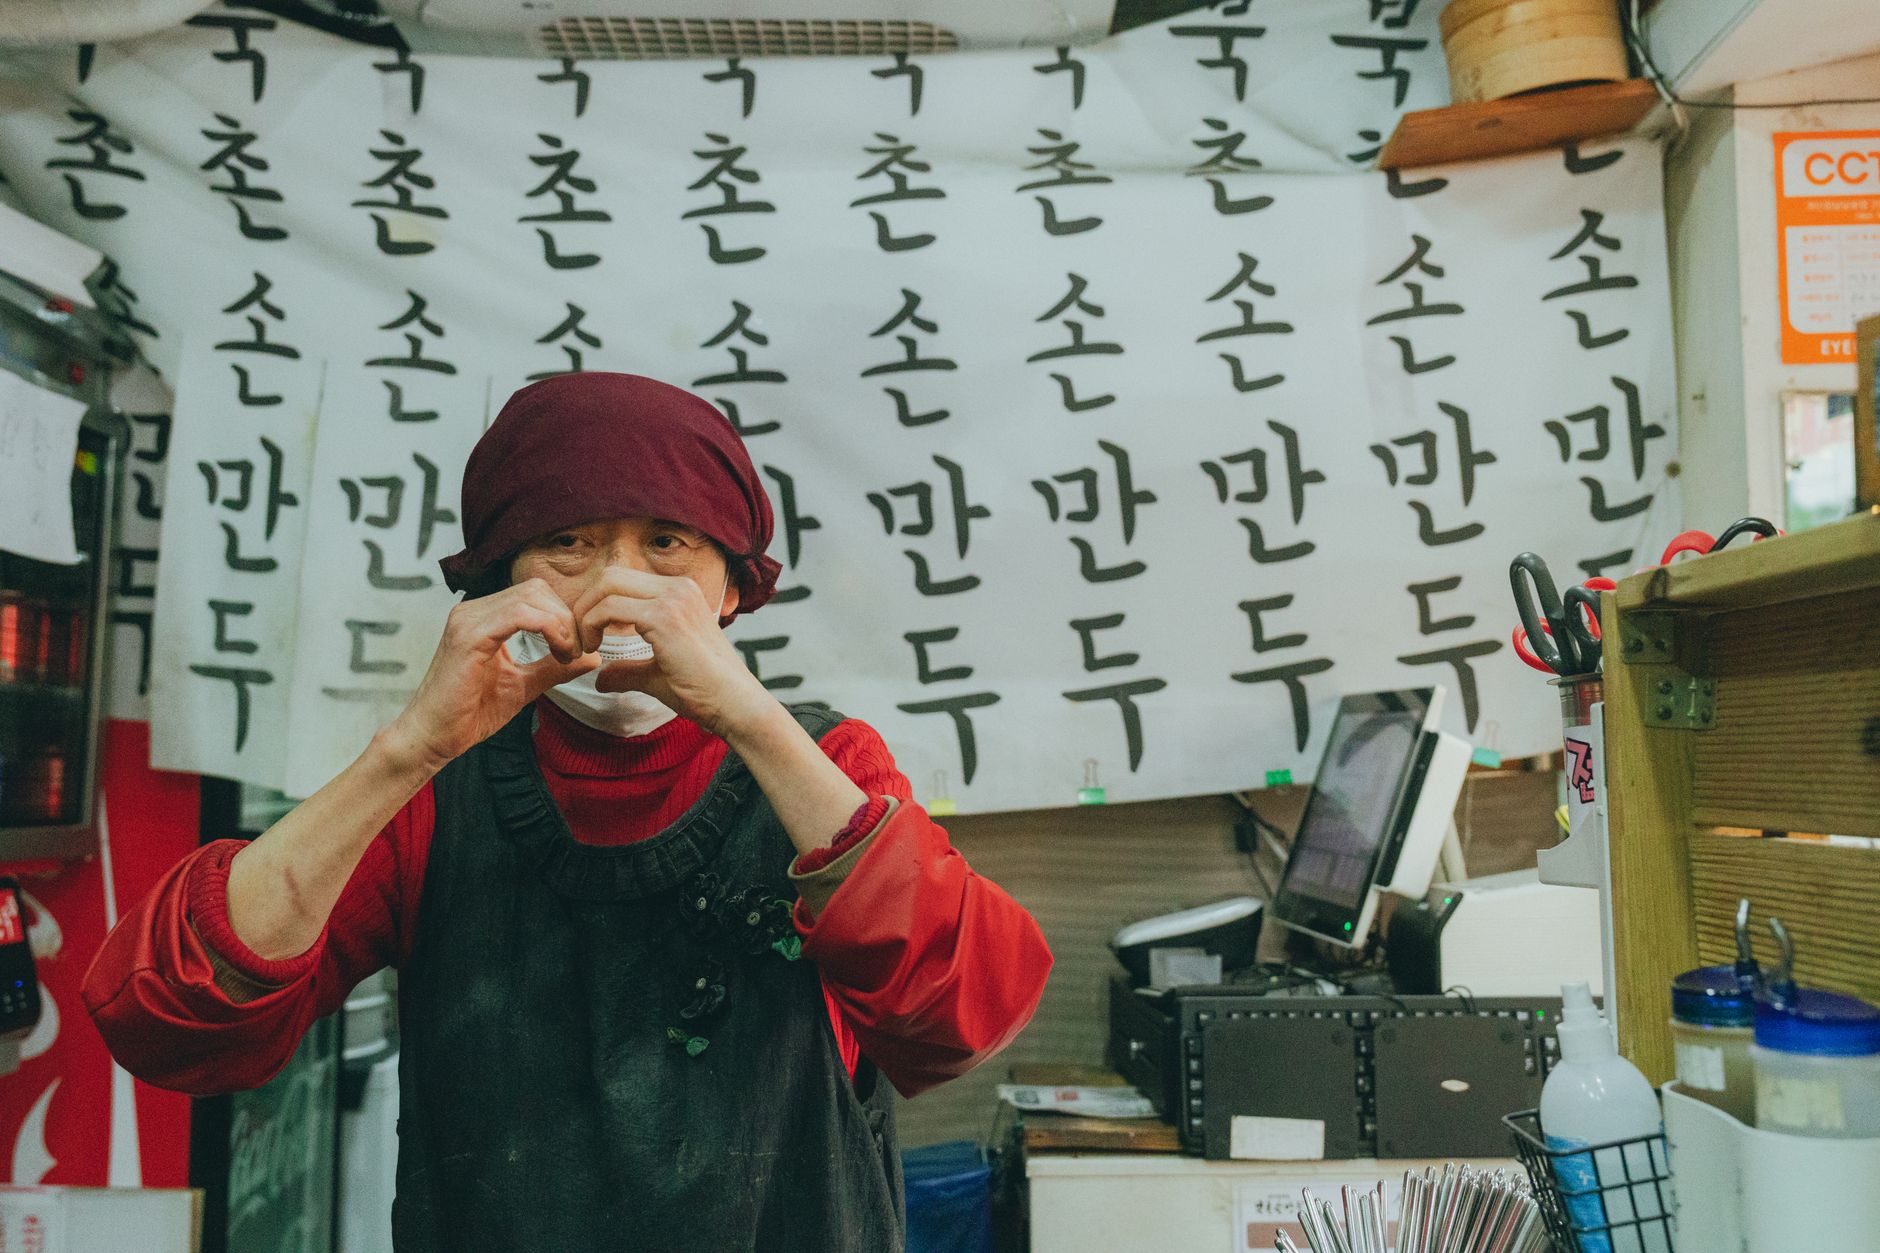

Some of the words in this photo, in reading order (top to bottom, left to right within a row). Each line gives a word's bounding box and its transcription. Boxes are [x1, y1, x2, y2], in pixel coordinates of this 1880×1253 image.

[849, 51, 1001, 786] 촌손만두
[1014, 46, 1168, 773] 촌손만두
[1820, 339, 1857, 356] EYE
